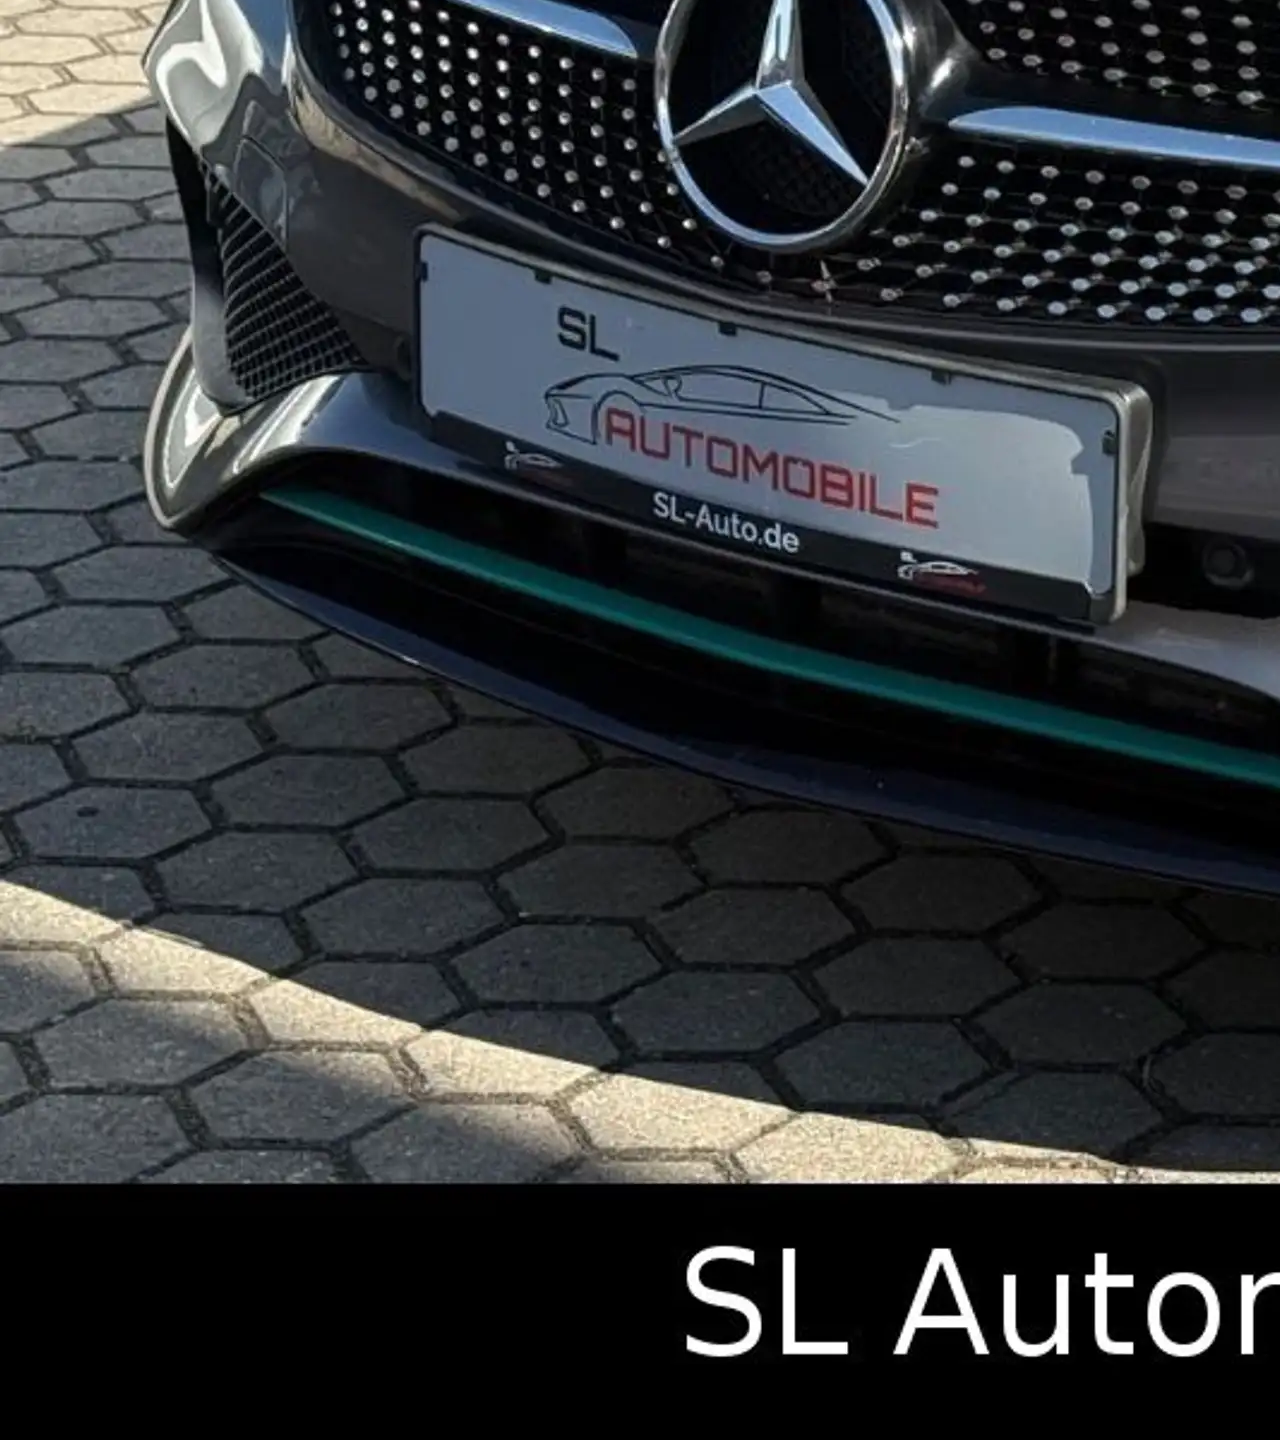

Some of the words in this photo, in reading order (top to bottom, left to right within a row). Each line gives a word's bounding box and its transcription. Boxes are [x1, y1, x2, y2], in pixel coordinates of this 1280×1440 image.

[557, 305, 619, 361] SL
[605, 407, 940, 528] AUTOMOBILE
[652, 490, 800, 554] SL-Auto.de
